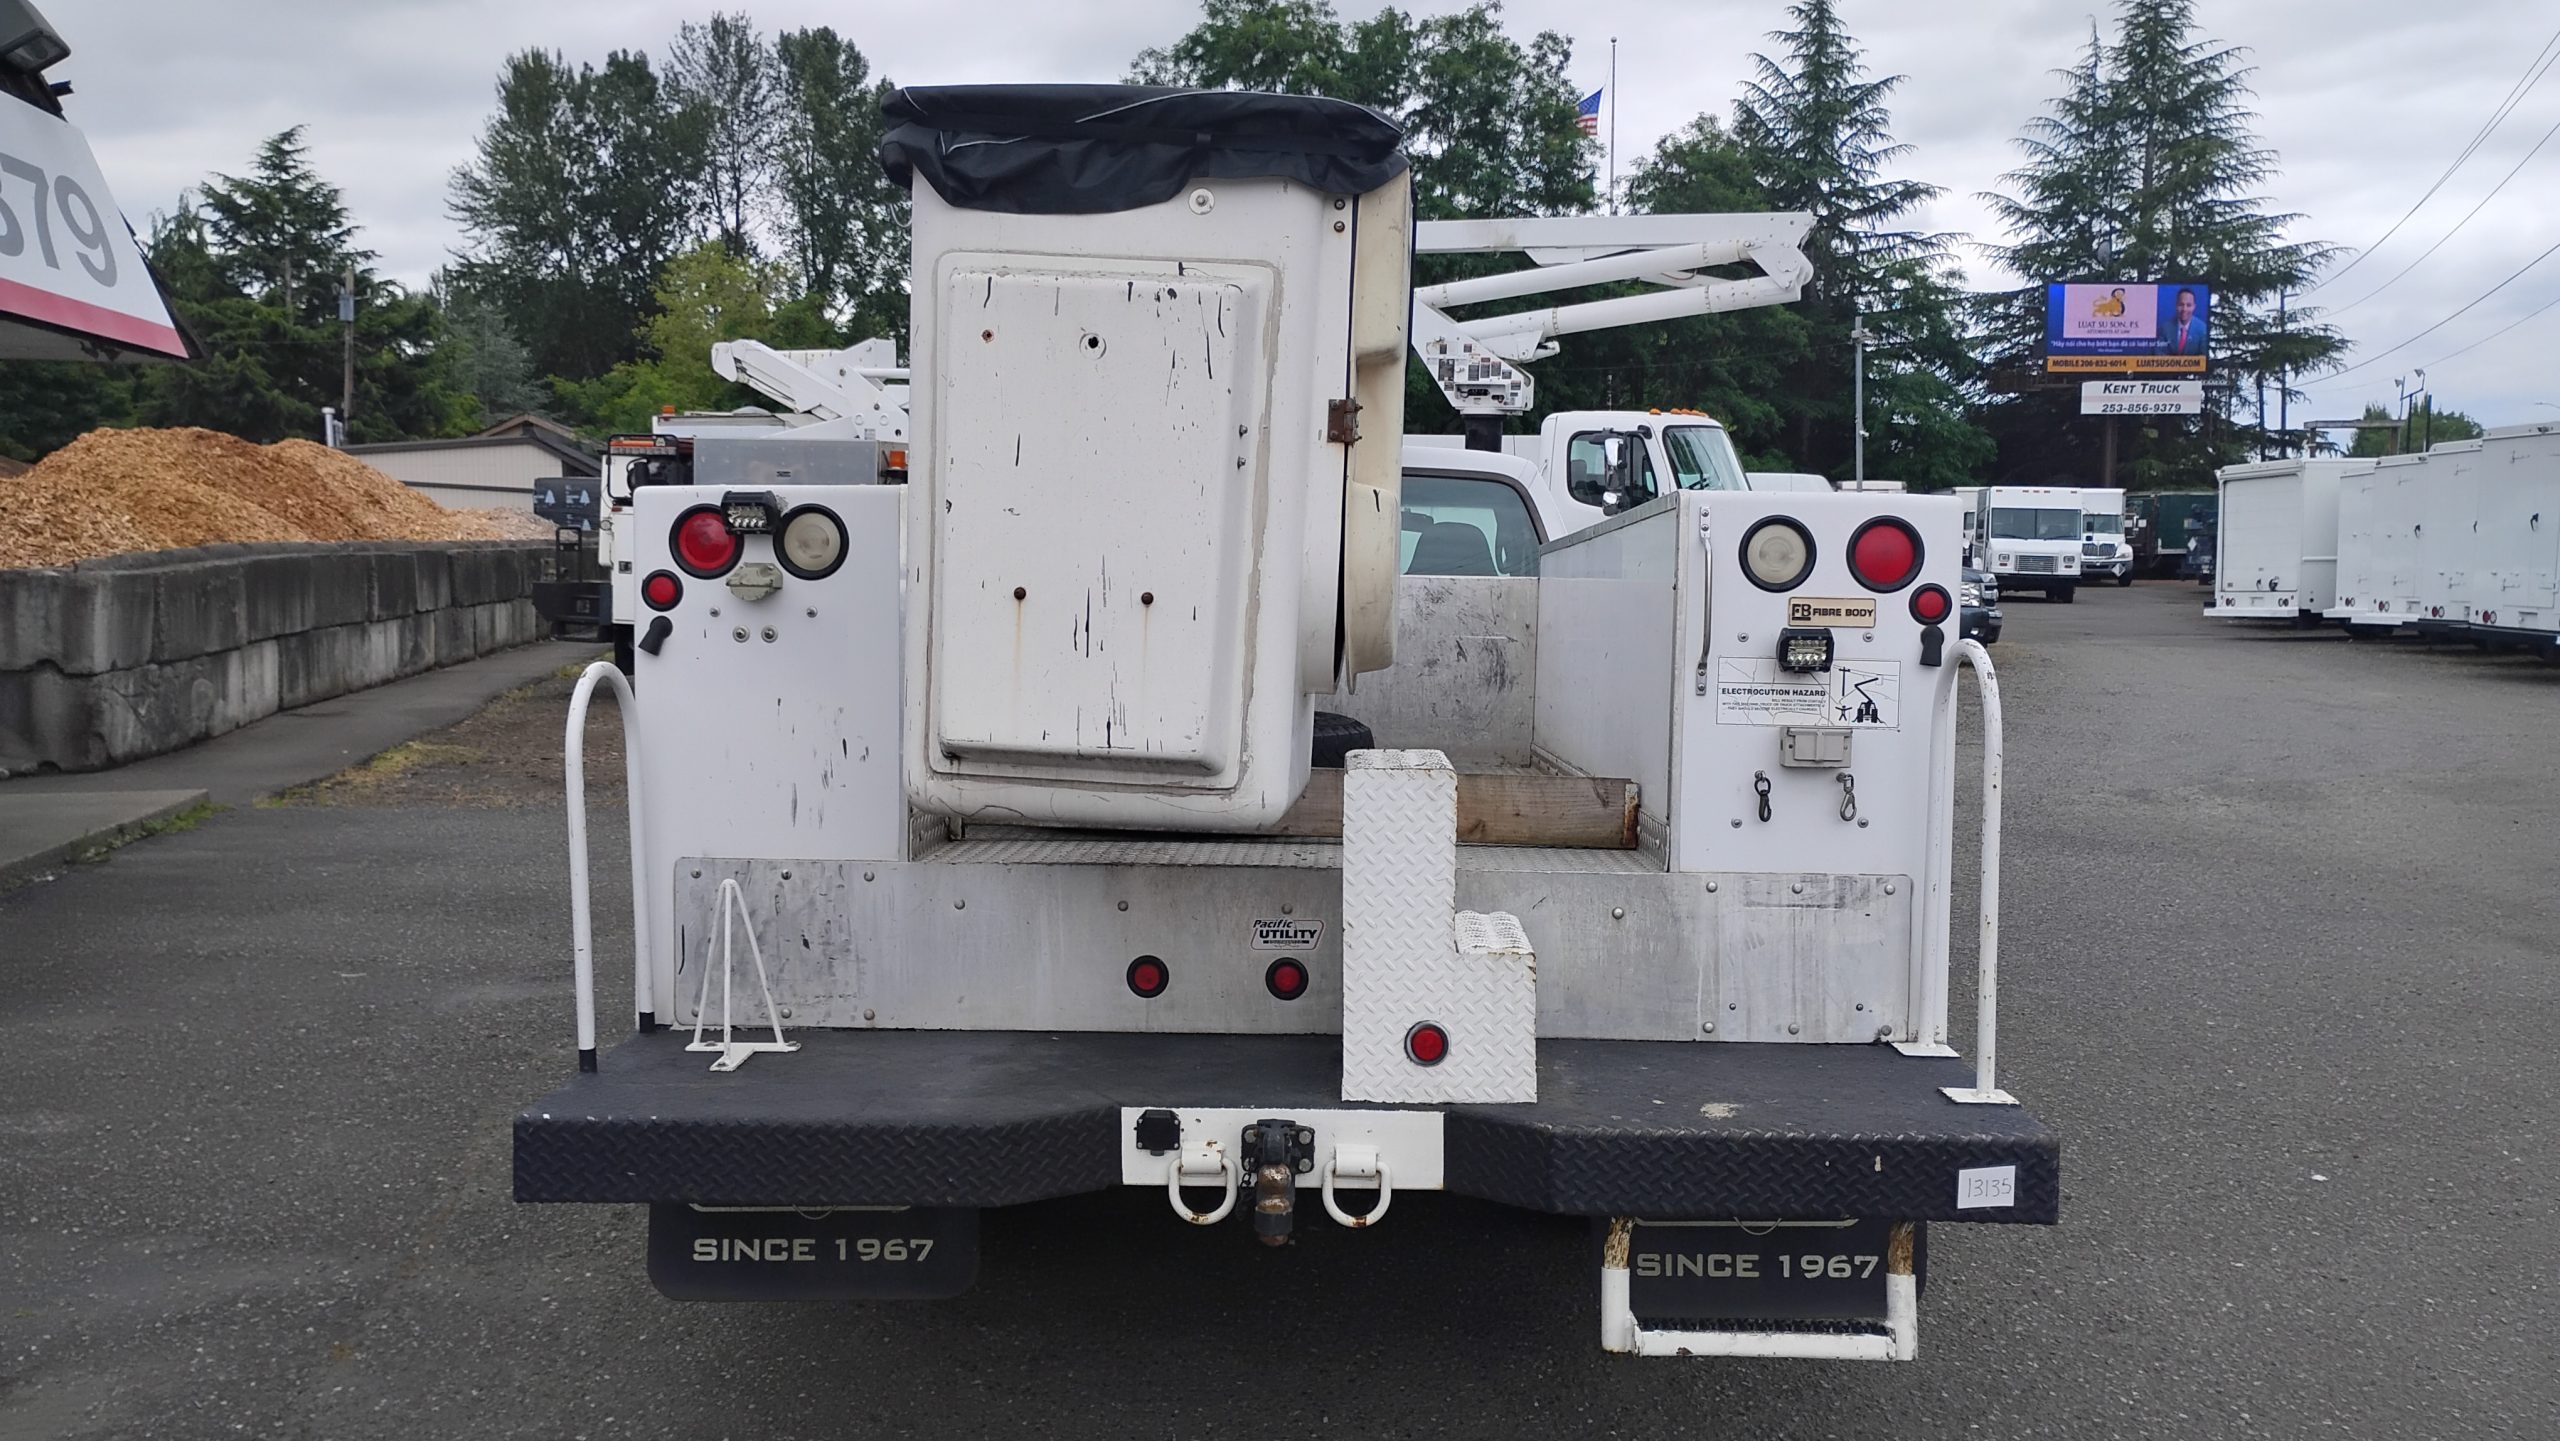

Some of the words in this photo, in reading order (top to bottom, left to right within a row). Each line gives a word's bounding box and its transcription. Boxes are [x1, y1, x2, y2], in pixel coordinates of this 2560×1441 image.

[2078, 321, 2096, 329] LUAT
[2098, 321, 2108, 329] SU
[2052, 360, 2079, 368] MOBILE
[2136, 360, 2200, 368] LUATSUSON.COM
[2103, 383, 2136, 394] KENT
[2140, 383, 2181, 394] TRUCK
[2101, 403, 2182, 413] 253-856-9379
[1813, 608, 1842, 617] FIBRE
[1845, 608, 1874, 617] BODY
[1721, 688, 1791, 696] ELECTROCUTION
[1792, 688, 1826, 697] HAZARD
[1253, 919, 1293, 929] Pacific
[1259, 929, 1318, 939] UTILITY
[1967, 1177, 2012, 1198] 13135
[692, 1238, 816, 1262] SINCE
[835, 1238, 934, 1262] 1967
[1636, 1253, 1760, 1278] SINCE
[1778, 1254, 1880, 1279] 1967
